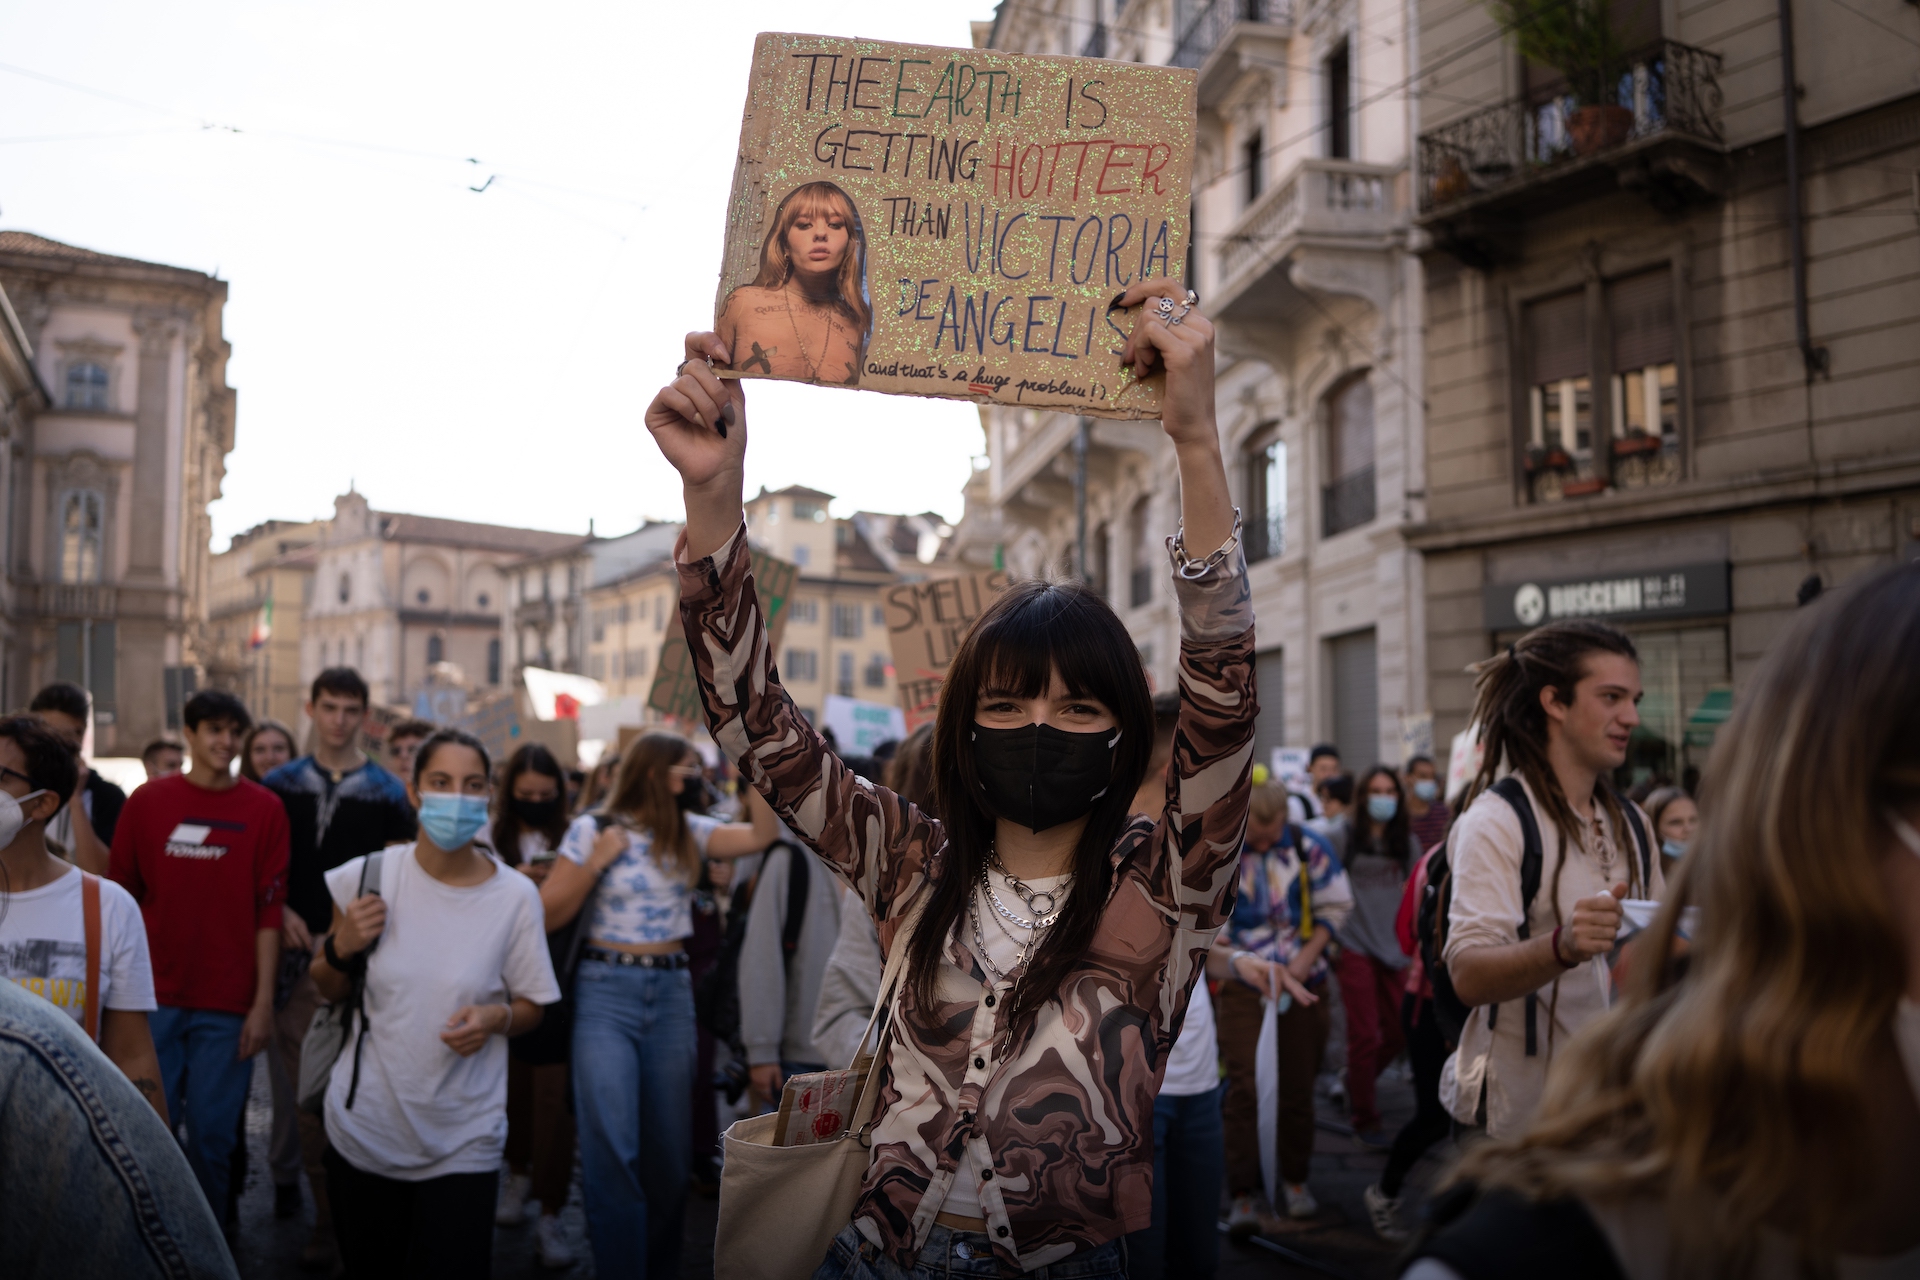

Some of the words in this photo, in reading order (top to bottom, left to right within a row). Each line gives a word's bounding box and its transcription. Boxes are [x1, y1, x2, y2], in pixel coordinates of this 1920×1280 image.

[792, 54, 891, 115] THE
[892, 59, 1022, 124] EARTH
[1065, 78, 1107, 129] IS
[815, 123, 983, 183] GETTING
[990, 137, 1172, 202] HOTTER
[883, 197, 951, 240] THAN
[965, 201, 1169, 286] VICTORIA
[952, 370, 967, 382] a
[971, 366, 1010, 392] huge
[1548, 578, 1641, 617] BUSCEMI
[165, 842, 228, 860] TOMMY
